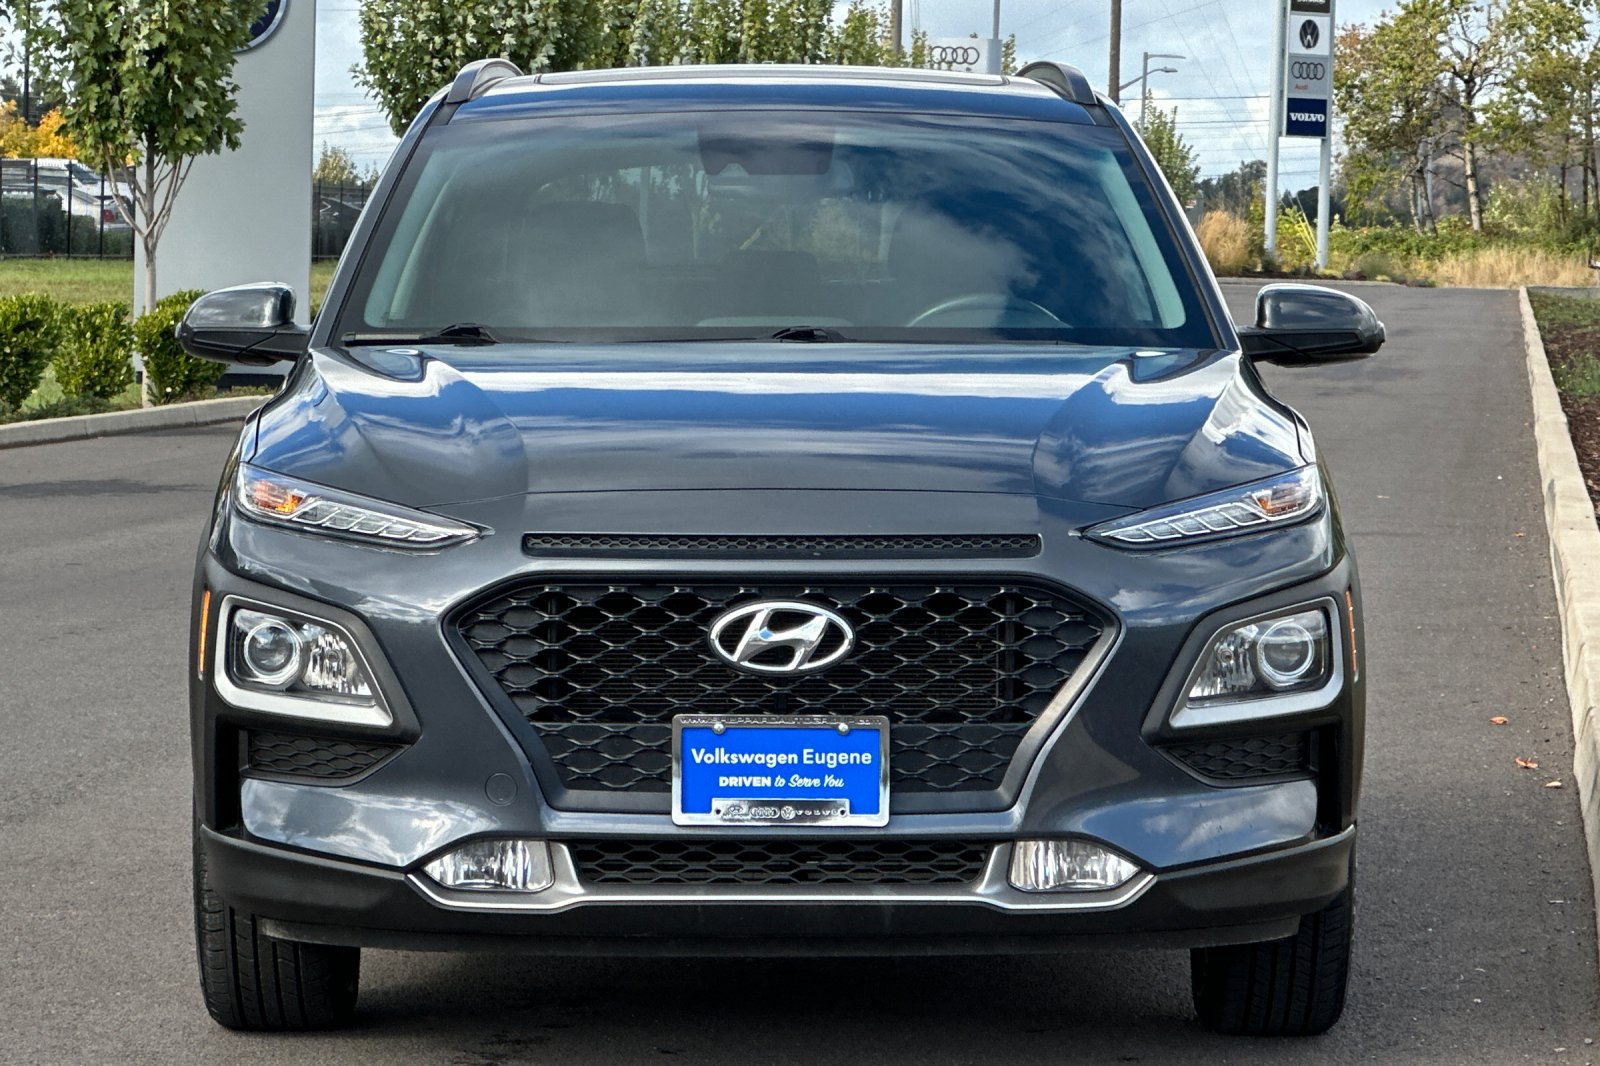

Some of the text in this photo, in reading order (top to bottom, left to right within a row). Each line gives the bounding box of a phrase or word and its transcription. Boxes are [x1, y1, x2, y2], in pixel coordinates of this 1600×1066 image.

[1289, 112, 1325, 123] VOLVO
[691, 747, 872, 768] Volkswagen Eugene
[719, 774, 845, 787] DRIVEN to Serve You
